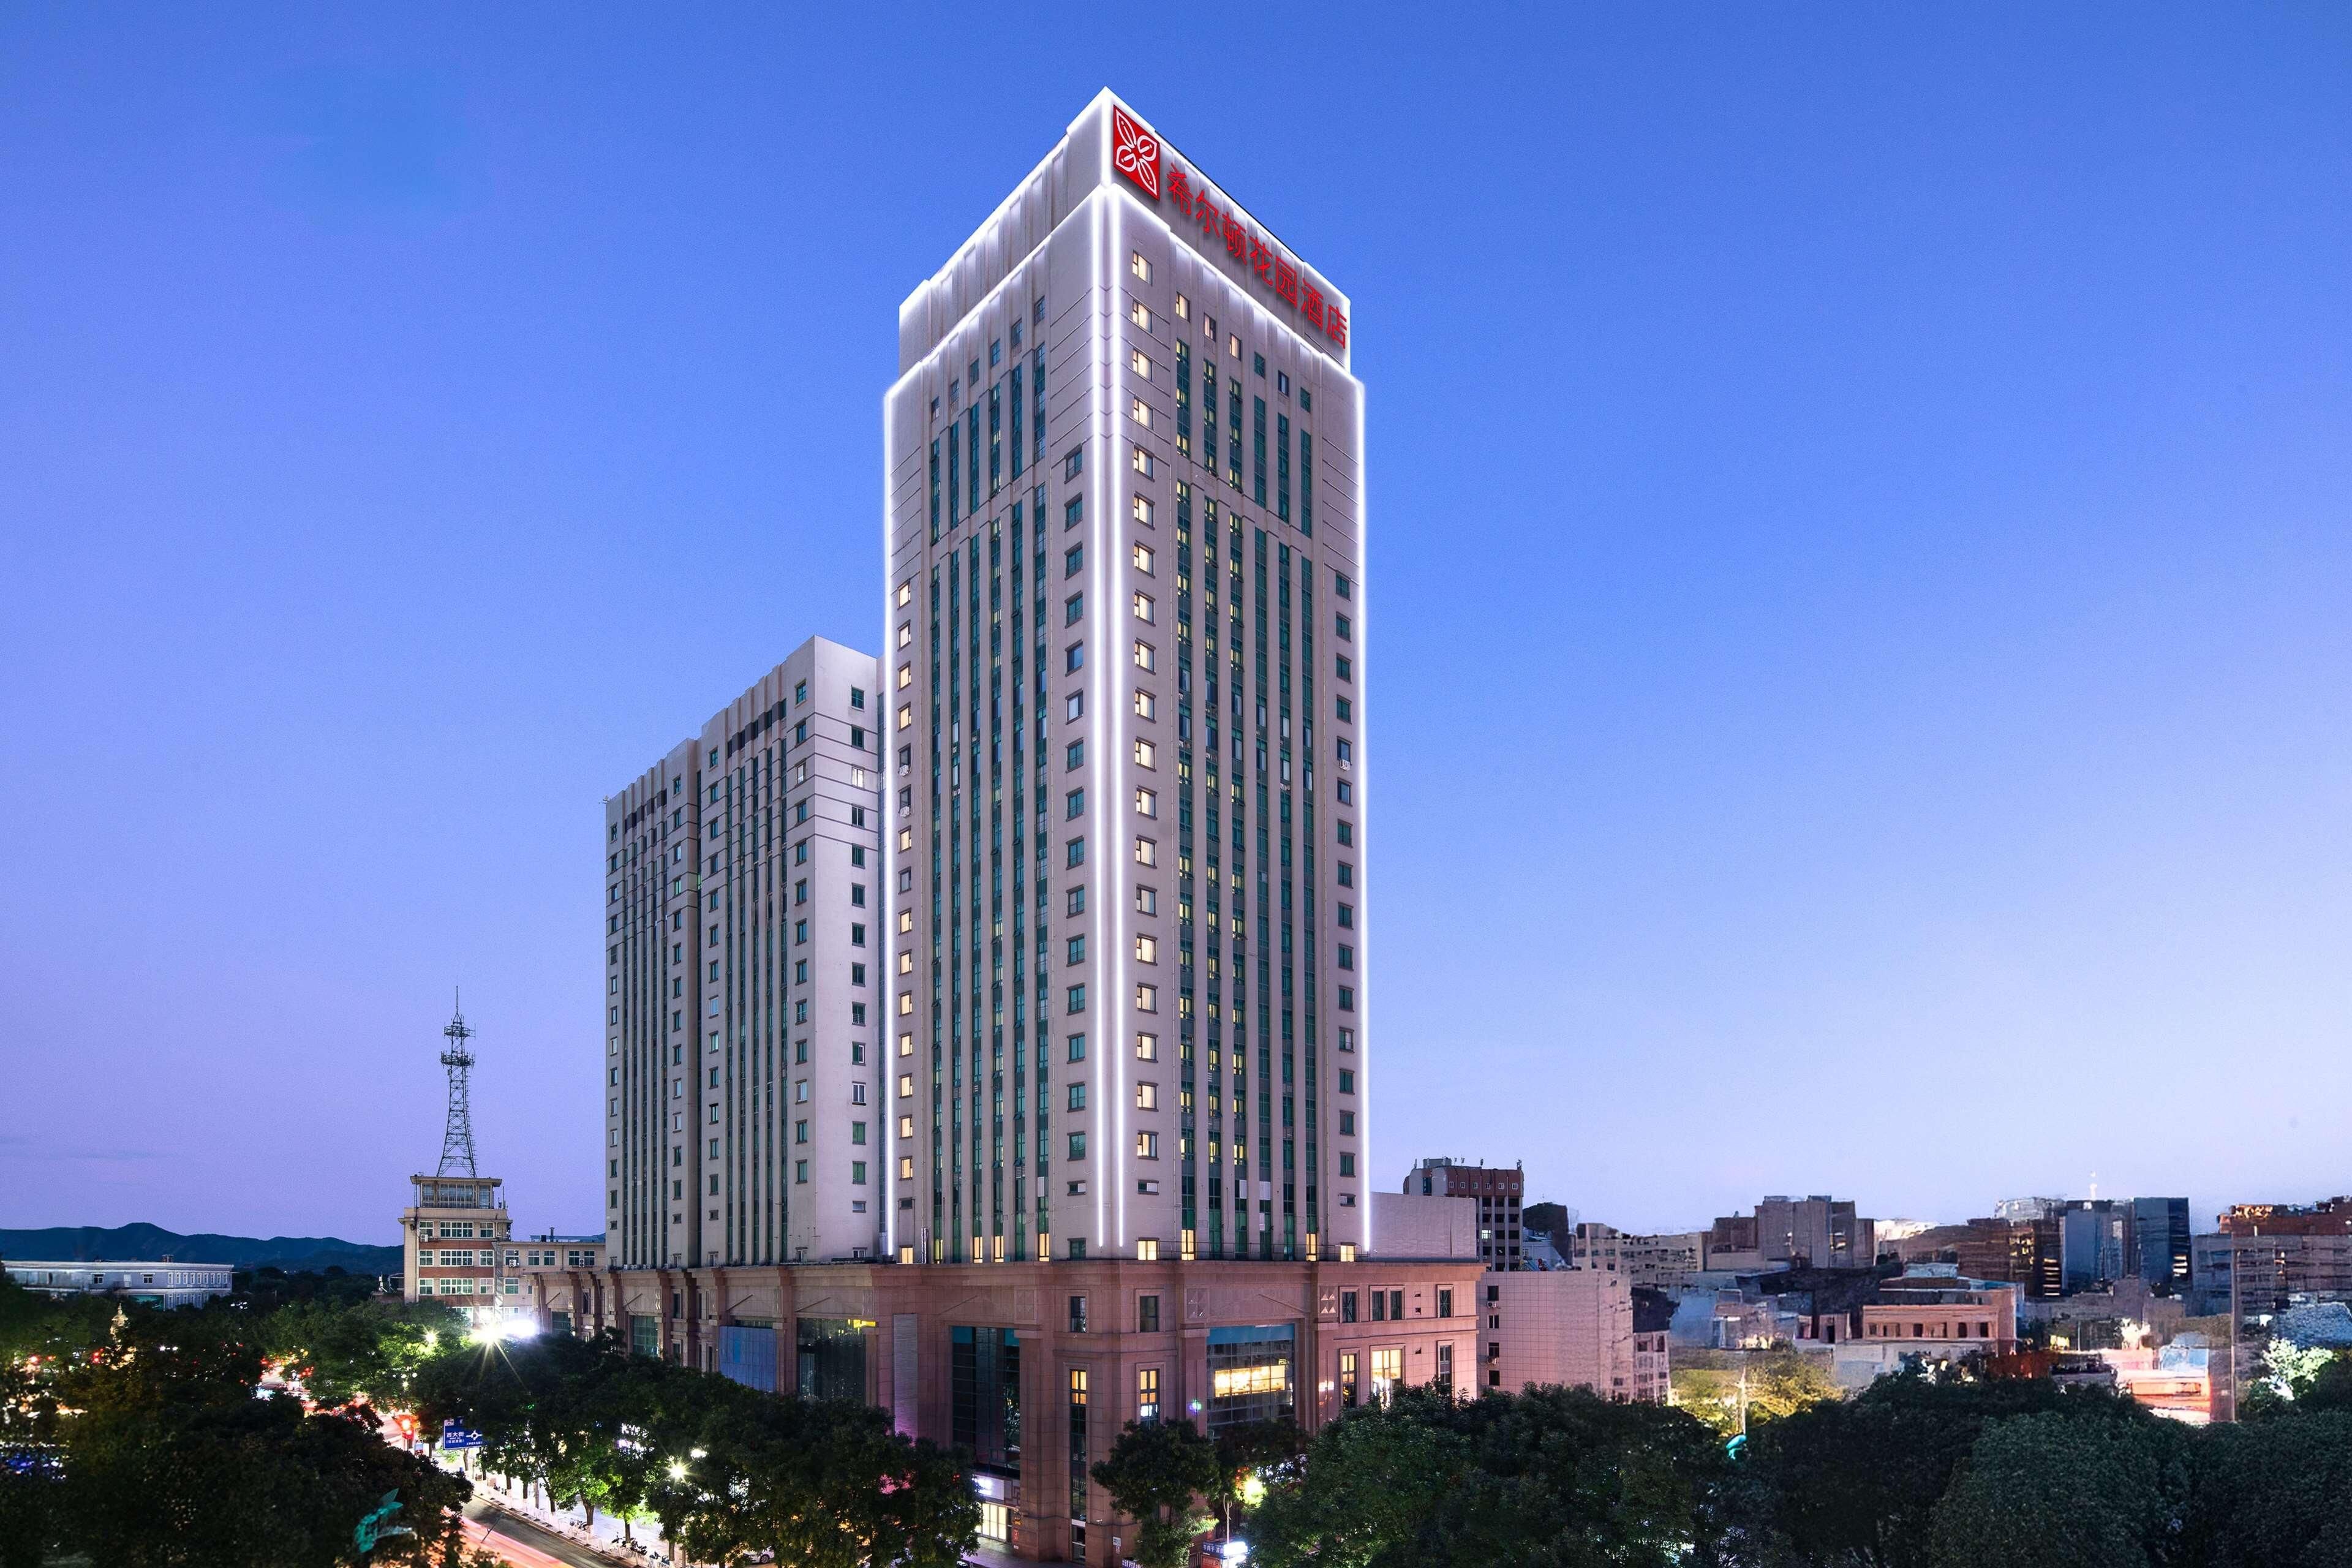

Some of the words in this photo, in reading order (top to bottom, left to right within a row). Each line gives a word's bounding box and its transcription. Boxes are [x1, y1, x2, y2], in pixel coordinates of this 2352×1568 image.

[1167, 163, 1348, 350] 希尔顿花园酒店
